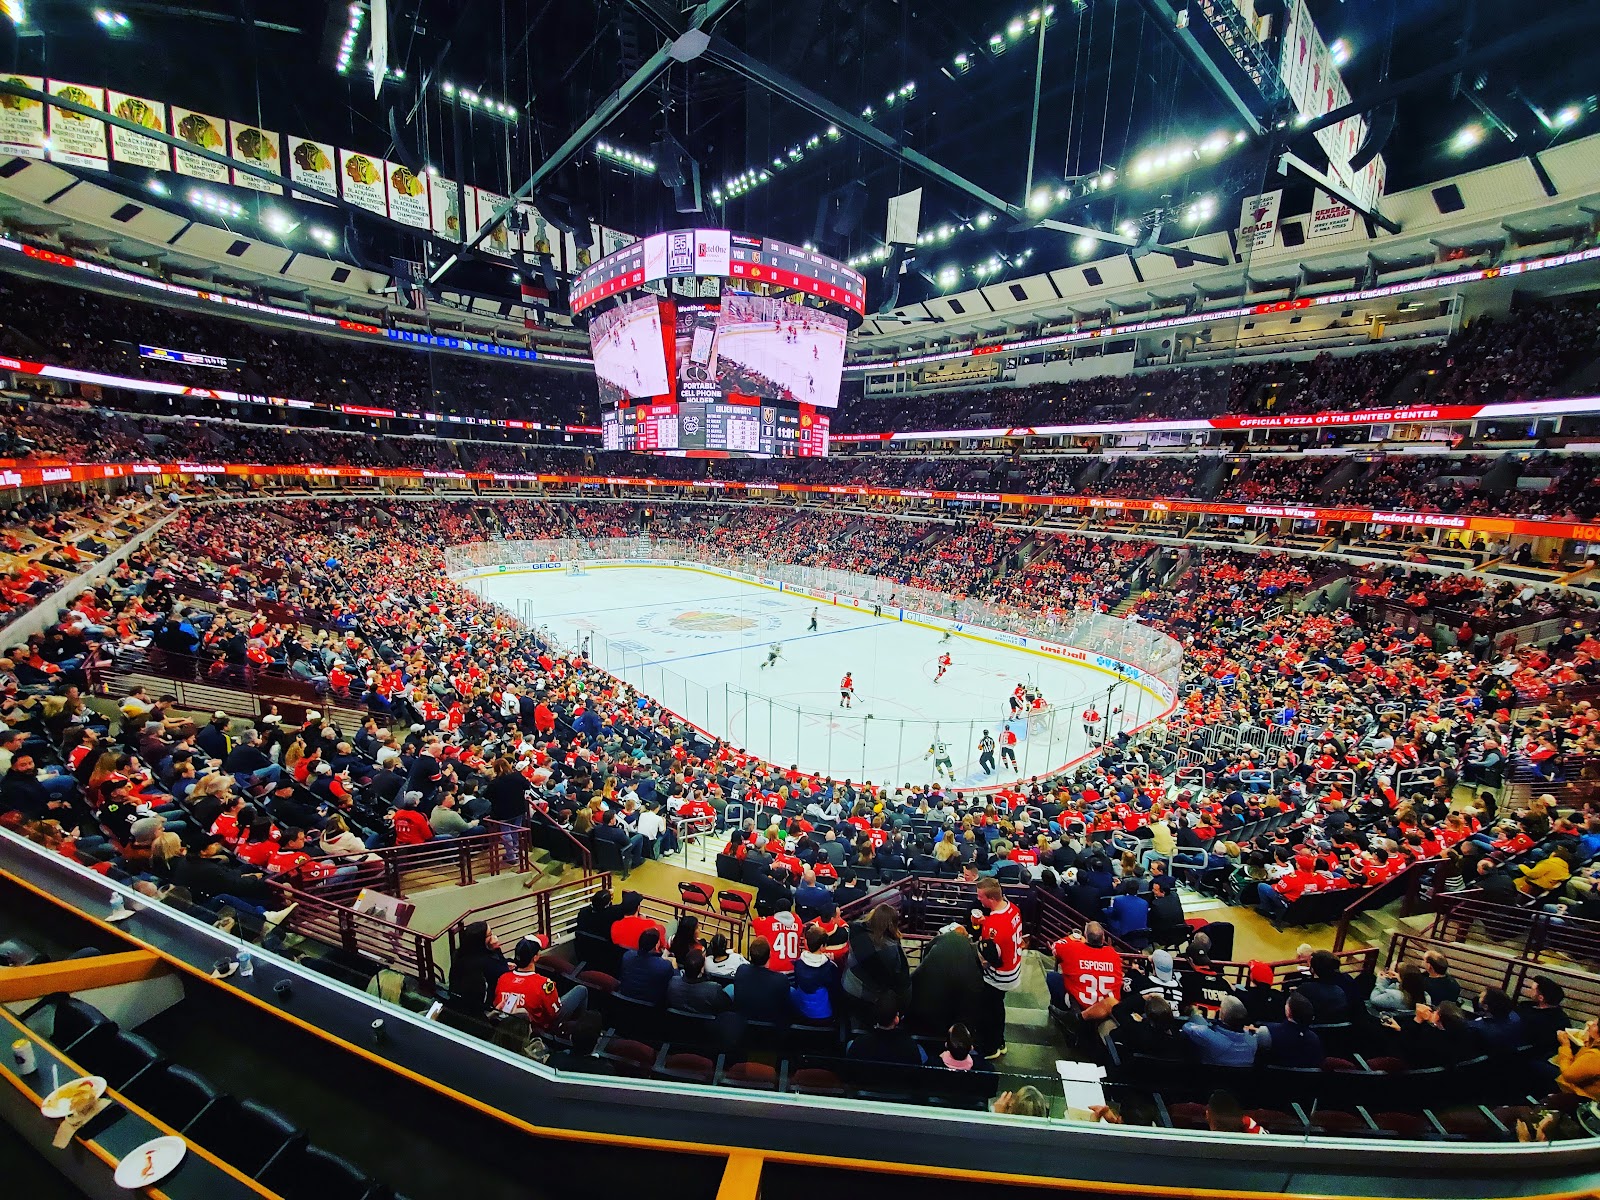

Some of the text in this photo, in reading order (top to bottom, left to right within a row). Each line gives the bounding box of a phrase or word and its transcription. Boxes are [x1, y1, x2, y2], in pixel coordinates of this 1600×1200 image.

[353, 183, 375, 192] CHICAGO
[1314, 209, 1351, 222] MANAGER
[1241, 220, 1273, 235] COACH
[675, 239, 686, 248] 25
[733, 250, 745, 260] VGK
[1528, 260, 1545, 270] THE
[1545, 258, 1565, 268] NEW
[1565, 254, 1581, 264] ERA
[733, 265, 744, 274] CHI
[1316, 271, 1482, 304] THE NEW ERA CHICAGO BLACKHAWKS COLLECTION
[677, 304, 706, 313] Weather
[387, 328, 460, 349] UNITED
[476, 342, 538, 360] CENTER
[715, 405, 733, 413] GOLDEN
[1239, 417, 1282, 426] OFFICIAL
[1283, 416, 1314, 424] PIZZA
[1330, 414, 1351, 423] THE
[1352, 411, 1392, 421] UNITED
[1394, 409, 1439, 419] CENTER
[277, 467, 306, 475] HOOTERS
[580, 476, 605, 484] HOOTERS
[917, 491, 933, 499] Wings
[956, 492, 976, 500] Seafood
[1052, 498, 1086, 507] HOOTERS
[1090, 500, 1105, 508] Get
[1105, 500, 1123, 509] Your
[1151, 502, 1168, 511] On.
[1245, 507, 1284, 517] Chicken
[1284, 509, 1316, 521] Wings
[1371, 513, 1415, 524] Seafood
[1415, 515, 1424, 524] &
[1424, 515, 1465, 527] Salads
[532, 562, 561, 570] GEICO
[906, 611, 922, 623] GTL
[938, 744, 945, 754] 5
[772, 932, 799, 959] 40
[1079, 959, 1114, 972] ESPOSITO
[1078, 973, 1116, 1005] 35
